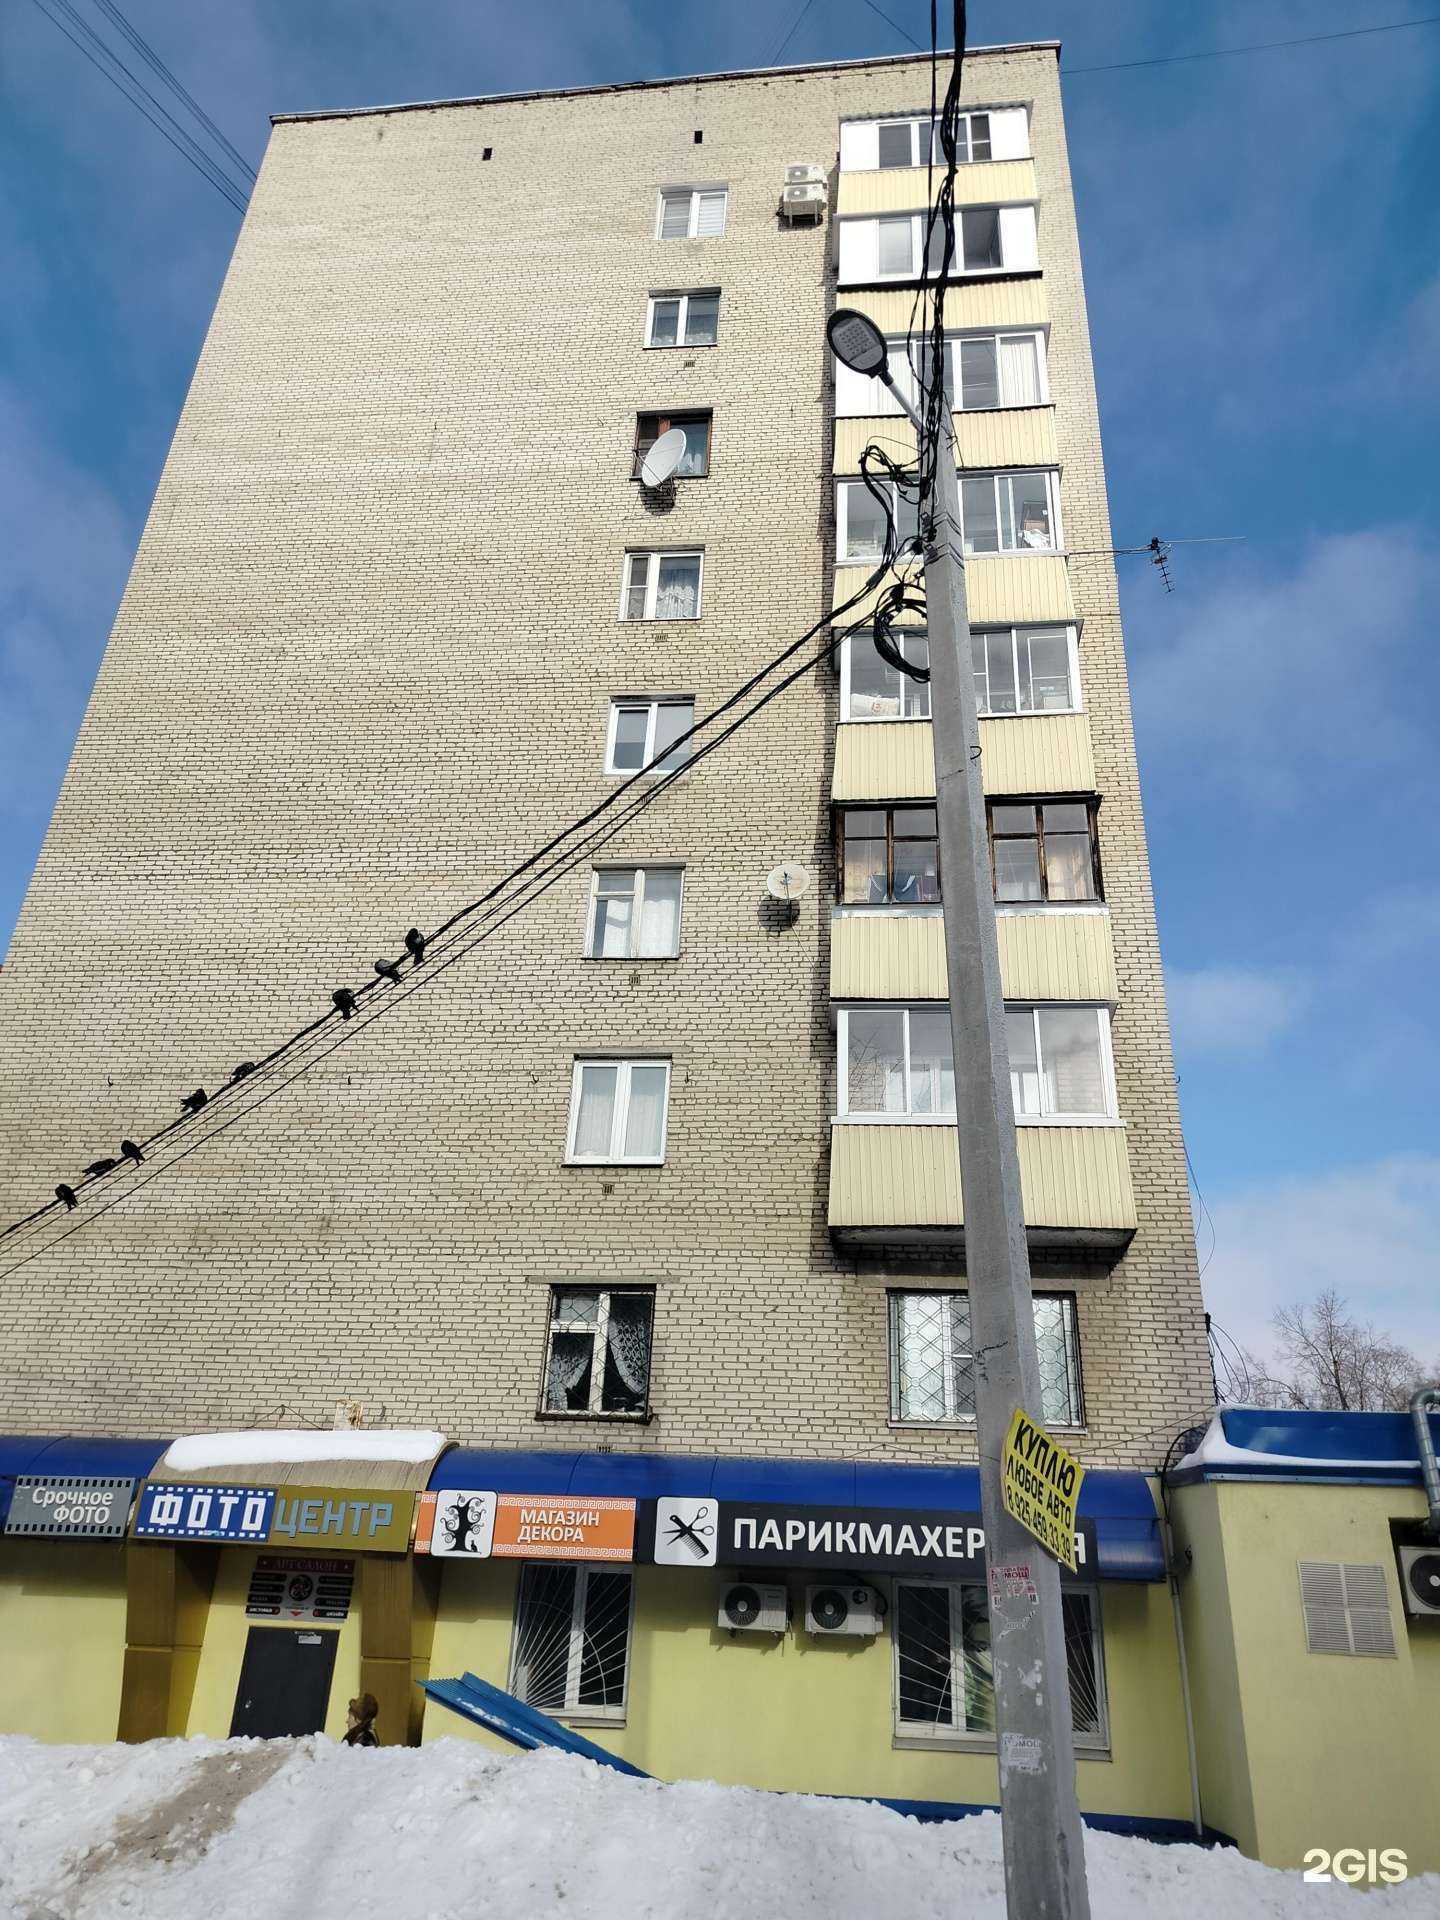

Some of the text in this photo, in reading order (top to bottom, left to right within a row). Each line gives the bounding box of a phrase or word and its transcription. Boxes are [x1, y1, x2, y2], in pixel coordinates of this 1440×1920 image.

[1014, 1419, 1075, 1497] КУПЛЮ
[32, 1486, 114, 1508] Срочное
[1007, 1455, 1071, 1529] ЛЮБОЕ АВТО
[1007, 1485, 1014, 1512] 8
[53, 1505, 111, 1525] ФОТО
[150, 1493, 393, 1538] ФОТО ЦЕНТР
[519, 1509, 600, 1527] МАГАЗИН
[517, 1525, 585, 1543] ДЕКОРА
[733, 1518, 1087, 1564] ПАРИКМАХЕРЯ
